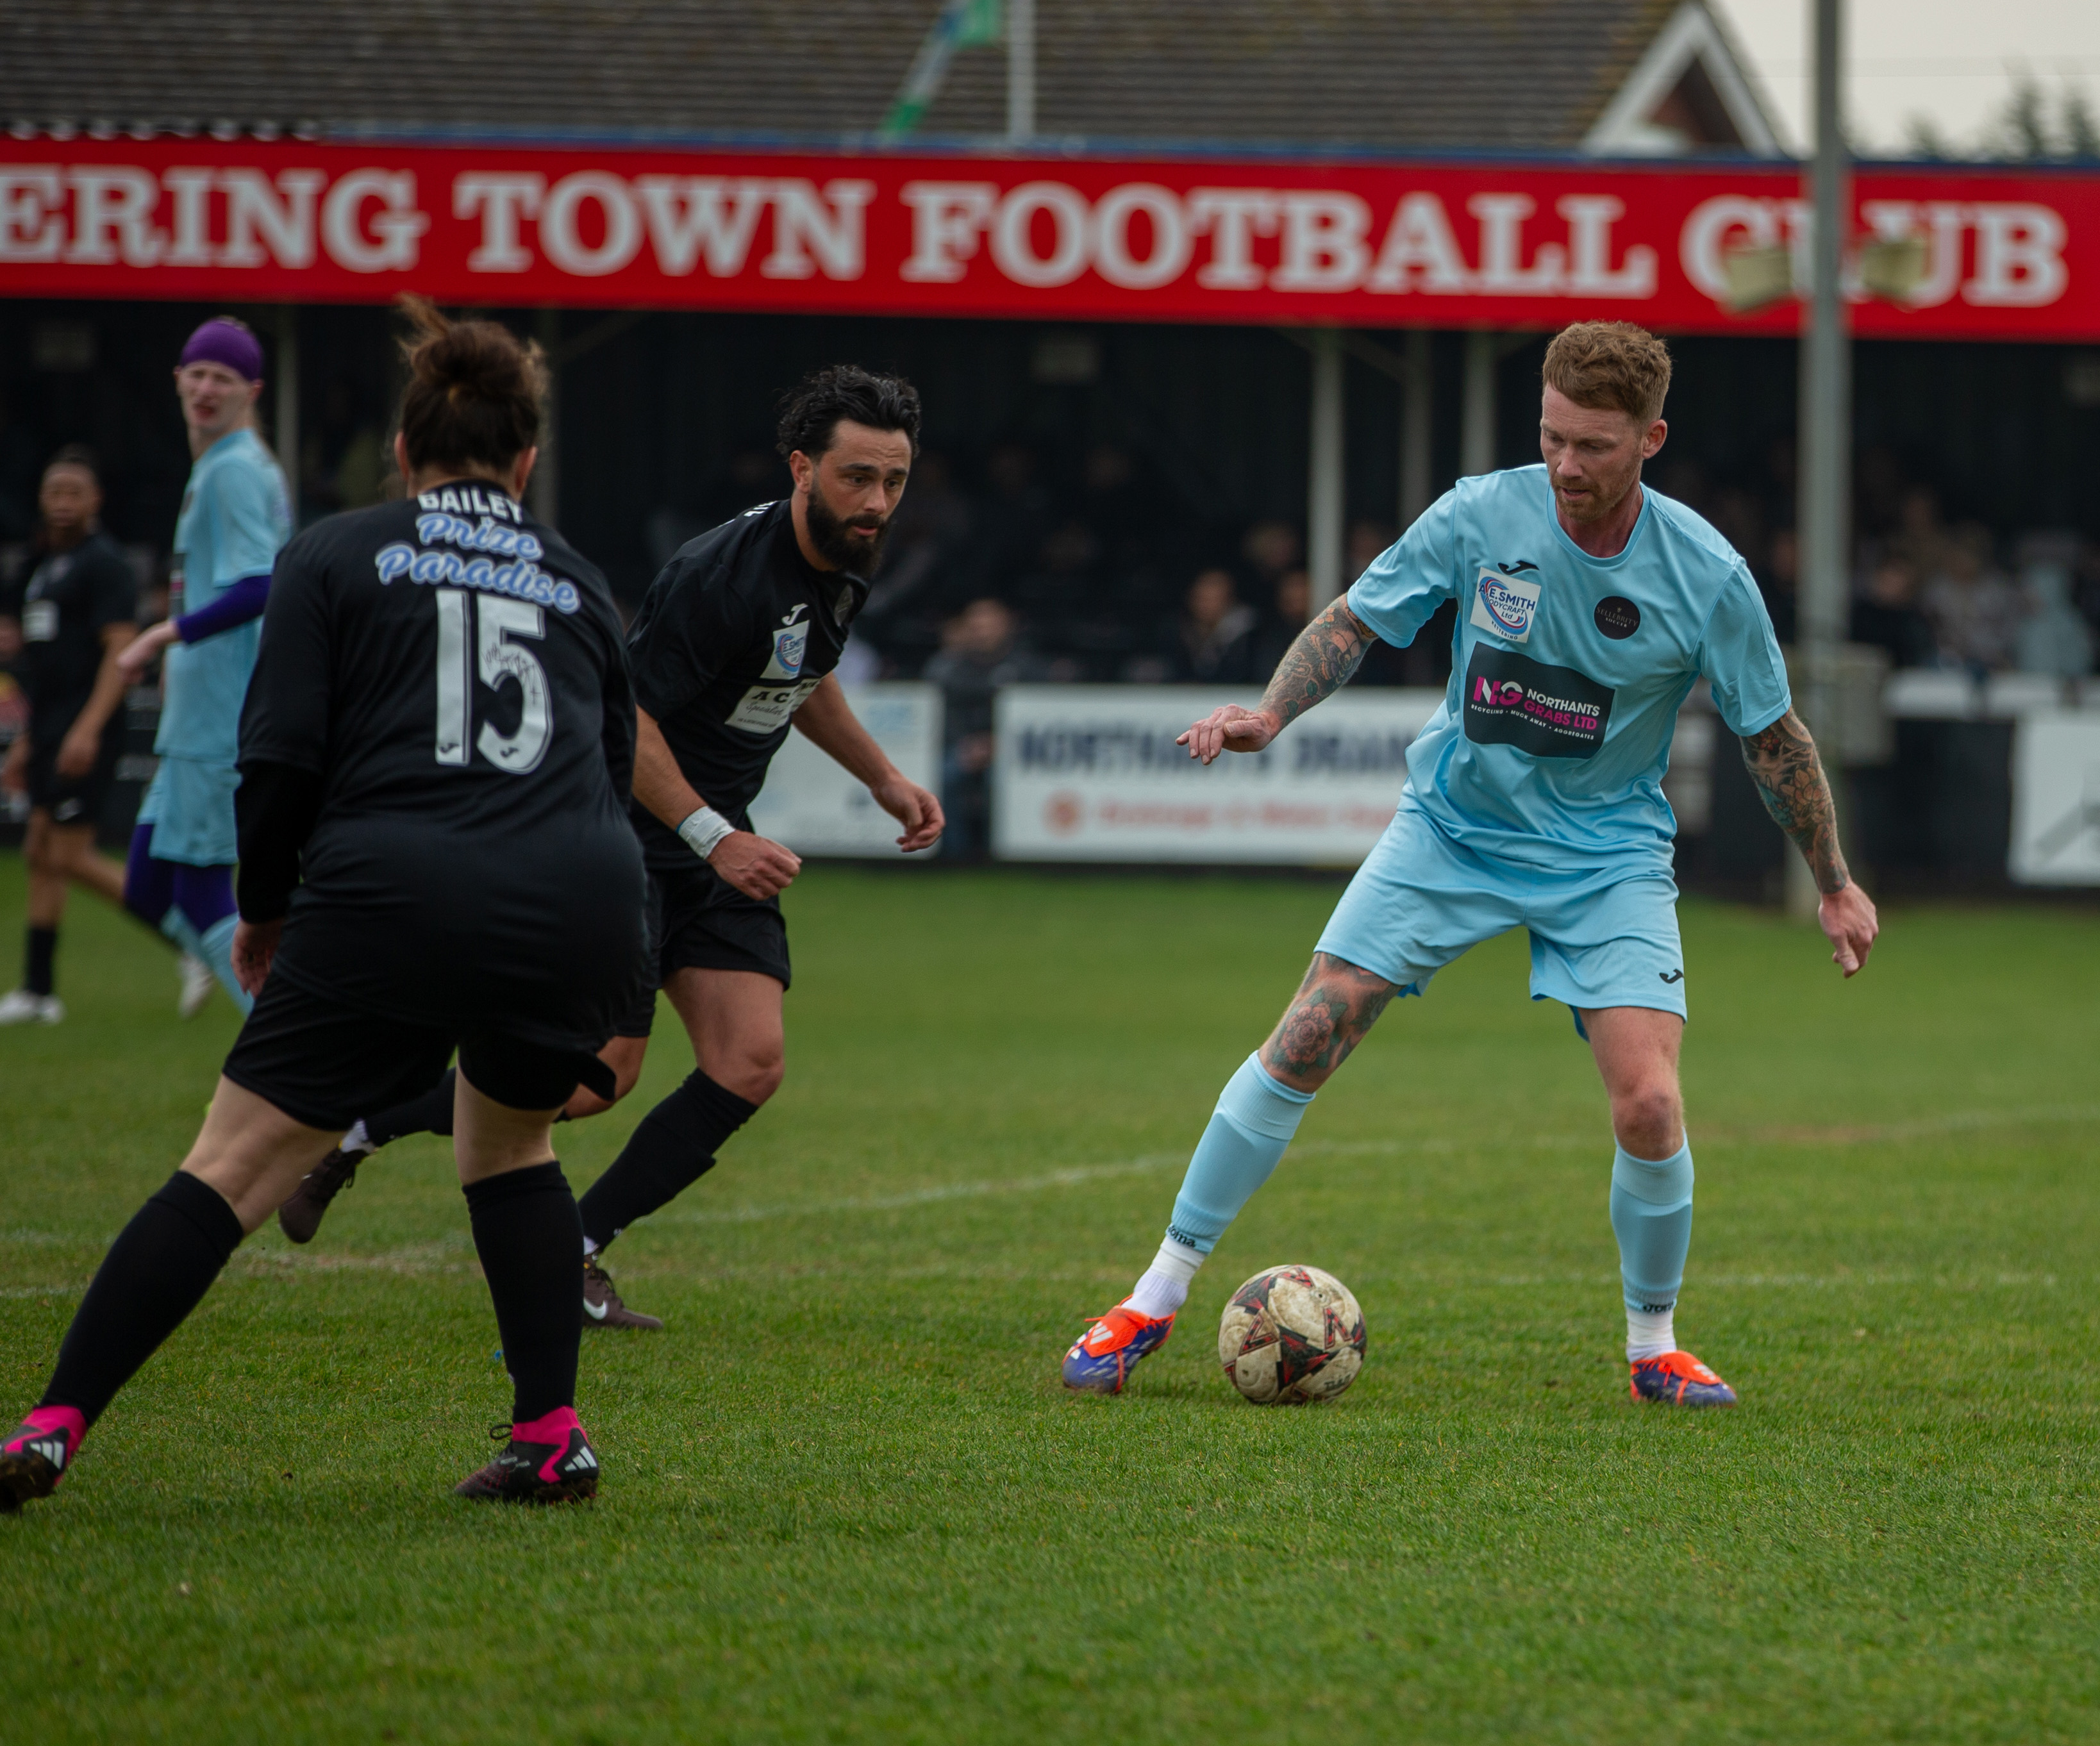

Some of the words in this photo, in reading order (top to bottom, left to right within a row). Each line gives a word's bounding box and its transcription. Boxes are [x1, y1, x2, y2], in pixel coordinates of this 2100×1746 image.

[0, 163, 431, 274] ERING
[451, 168, 877, 281] TOWN
[898, 179, 1658, 301] FOOTBALL
[1678, 193, 2071, 310] CUB
[417, 485, 523, 524] BAILEY
[415, 511, 545, 561] Prize
[374, 544, 581, 615] Paradise
[1478, 584, 1537, 611] A.E.SMITH
[1485, 597, 1526, 616] BODYCRAFT
[1491, 620, 1519, 640] KETTERING
[1501, 611, 1514, 620] Ltd
[435, 588, 554, 775] 15
[1472, 676, 1524, 706] NG
[1523, 699, 1571, 727] GRABS
[1573, 715, 1597, 731] LTD
[1526, 688, 1601, 717] NORTHANTS
[1471, 704, 1504, 715] RECYCLING
[1510, 710, 1529, 720] MUCK
[1529, 717, 1547, 729] AWAY
[1553, 727, 1595, 741] AGGREGATES
